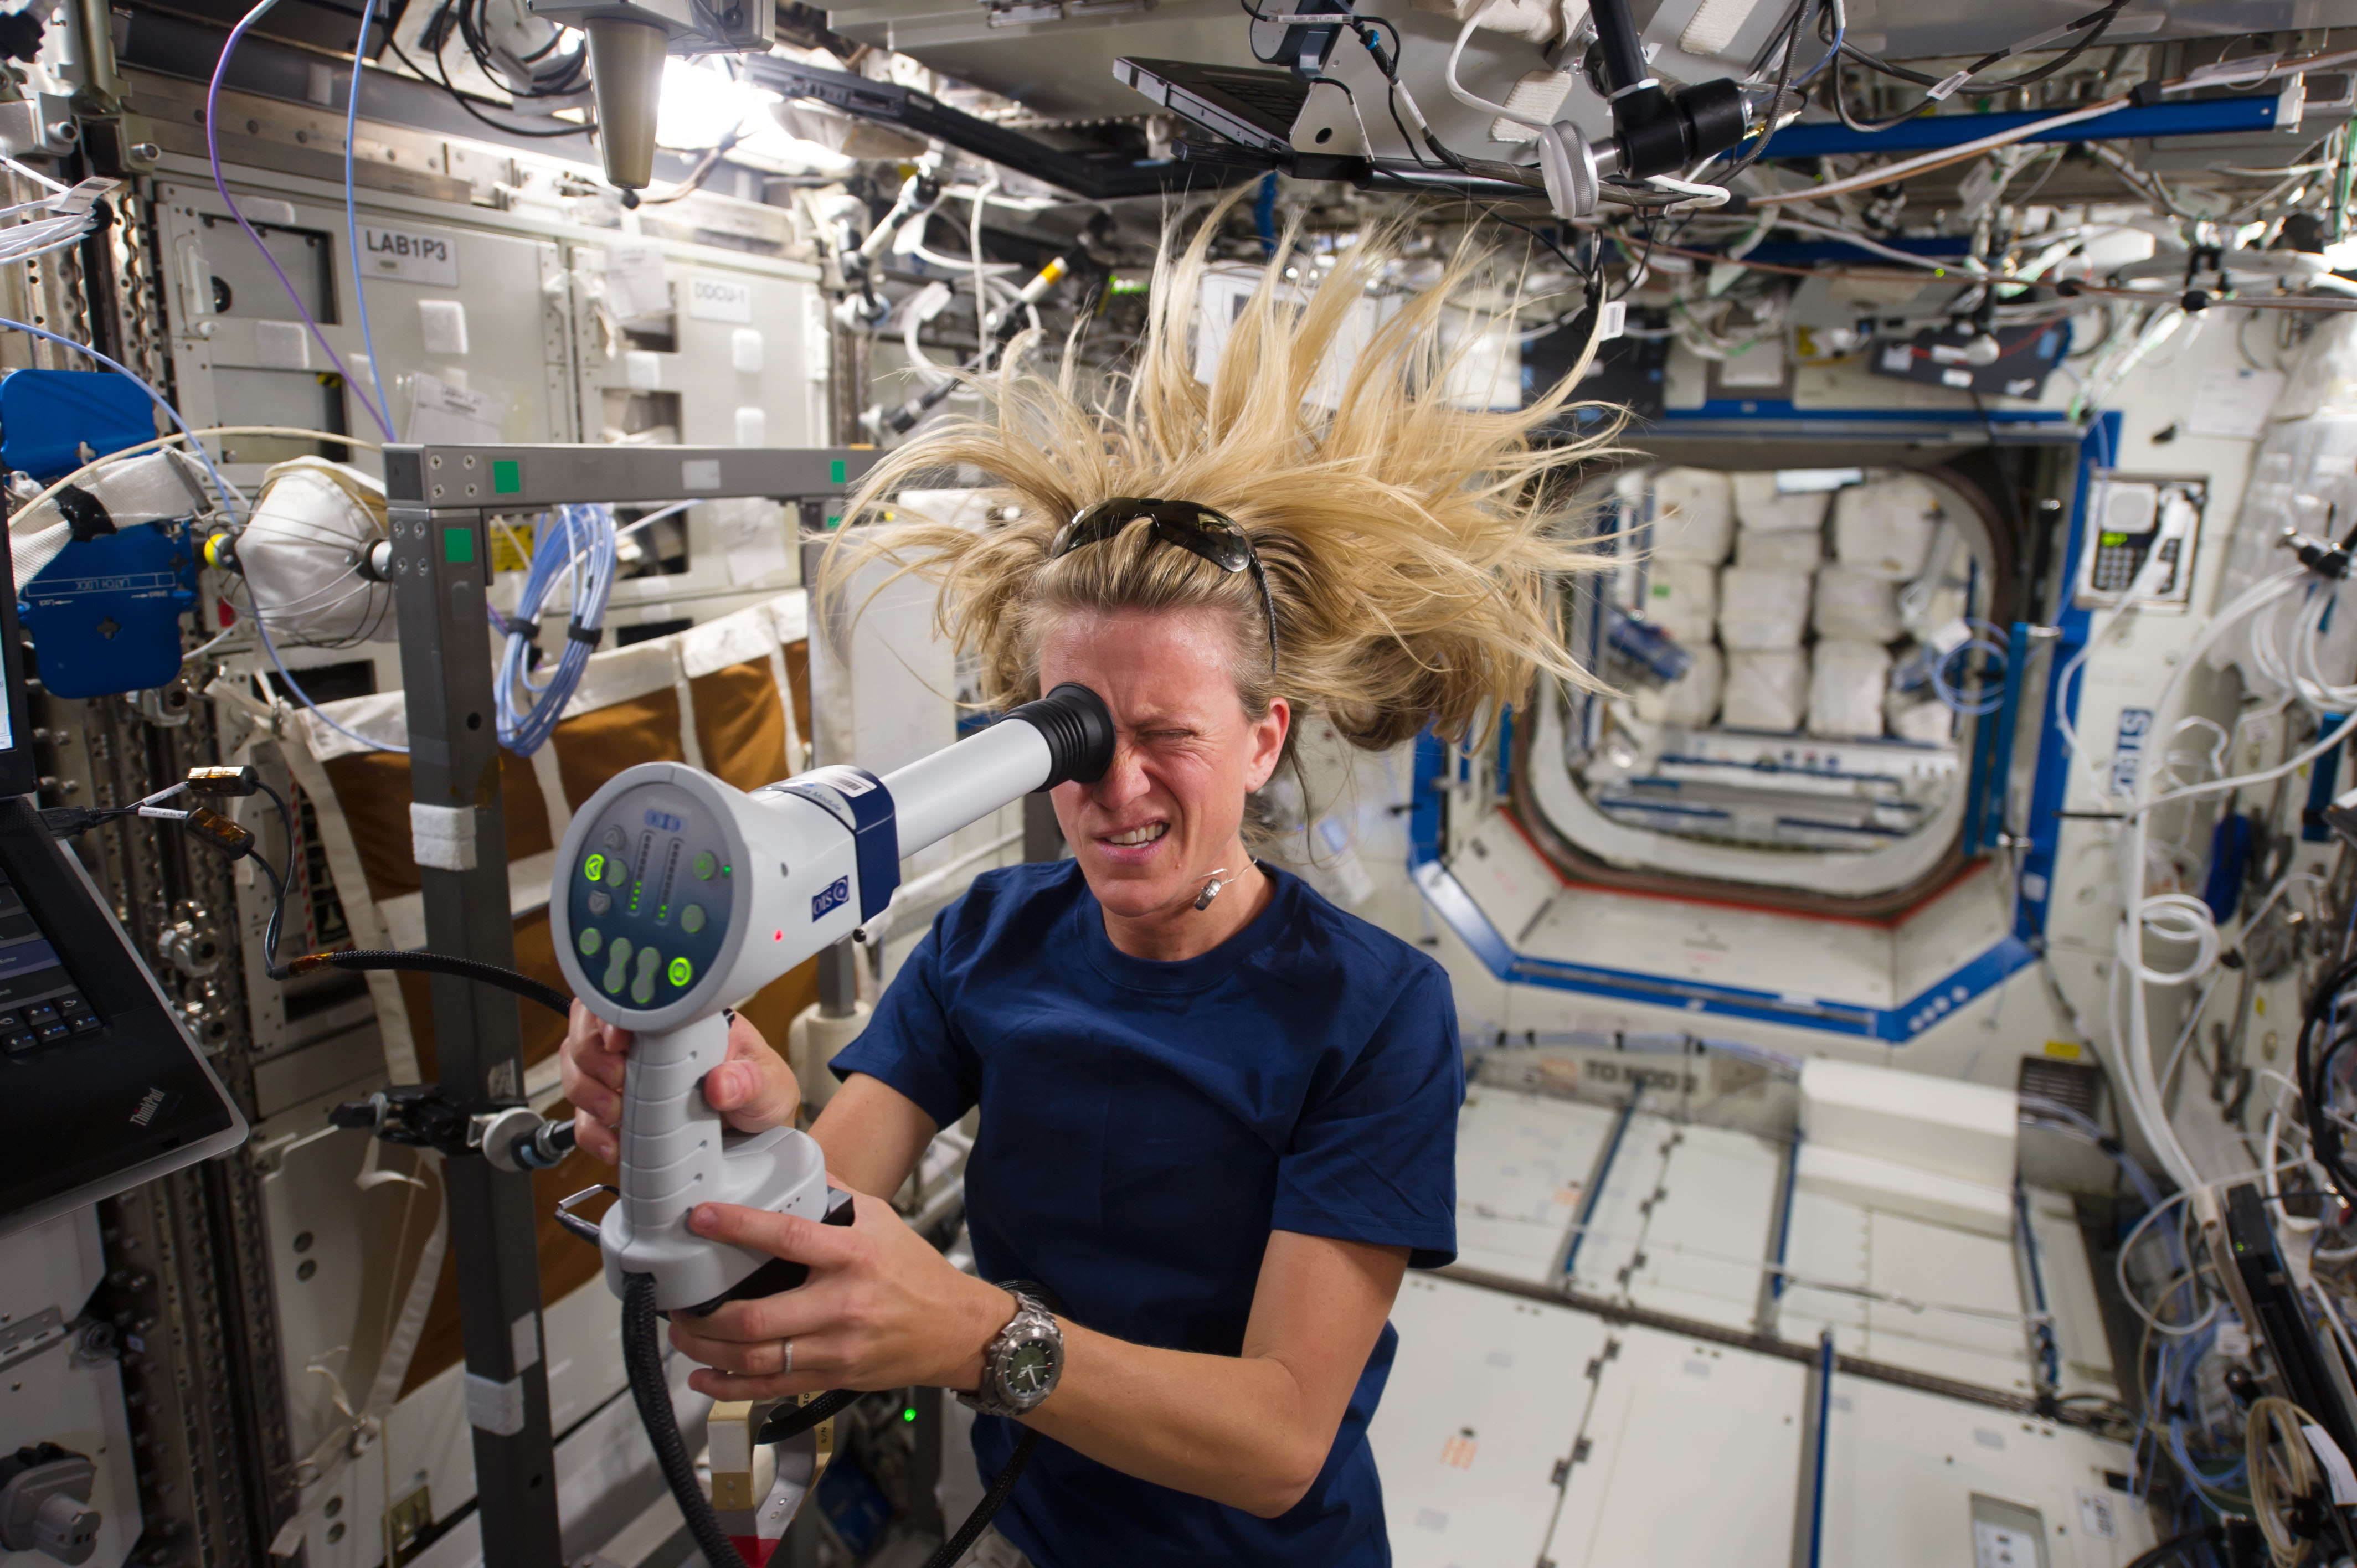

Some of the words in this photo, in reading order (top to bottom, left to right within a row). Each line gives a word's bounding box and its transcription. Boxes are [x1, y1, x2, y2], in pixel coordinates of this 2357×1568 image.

[366, 230, 447, 261] LAB1P3
[76, 580, 99, 590] LOCK
[102, 577, 130, 589] LATCH
[812, 890, 833, 915] OIS
[129, 1087, 166, 1126] ThinkPad
